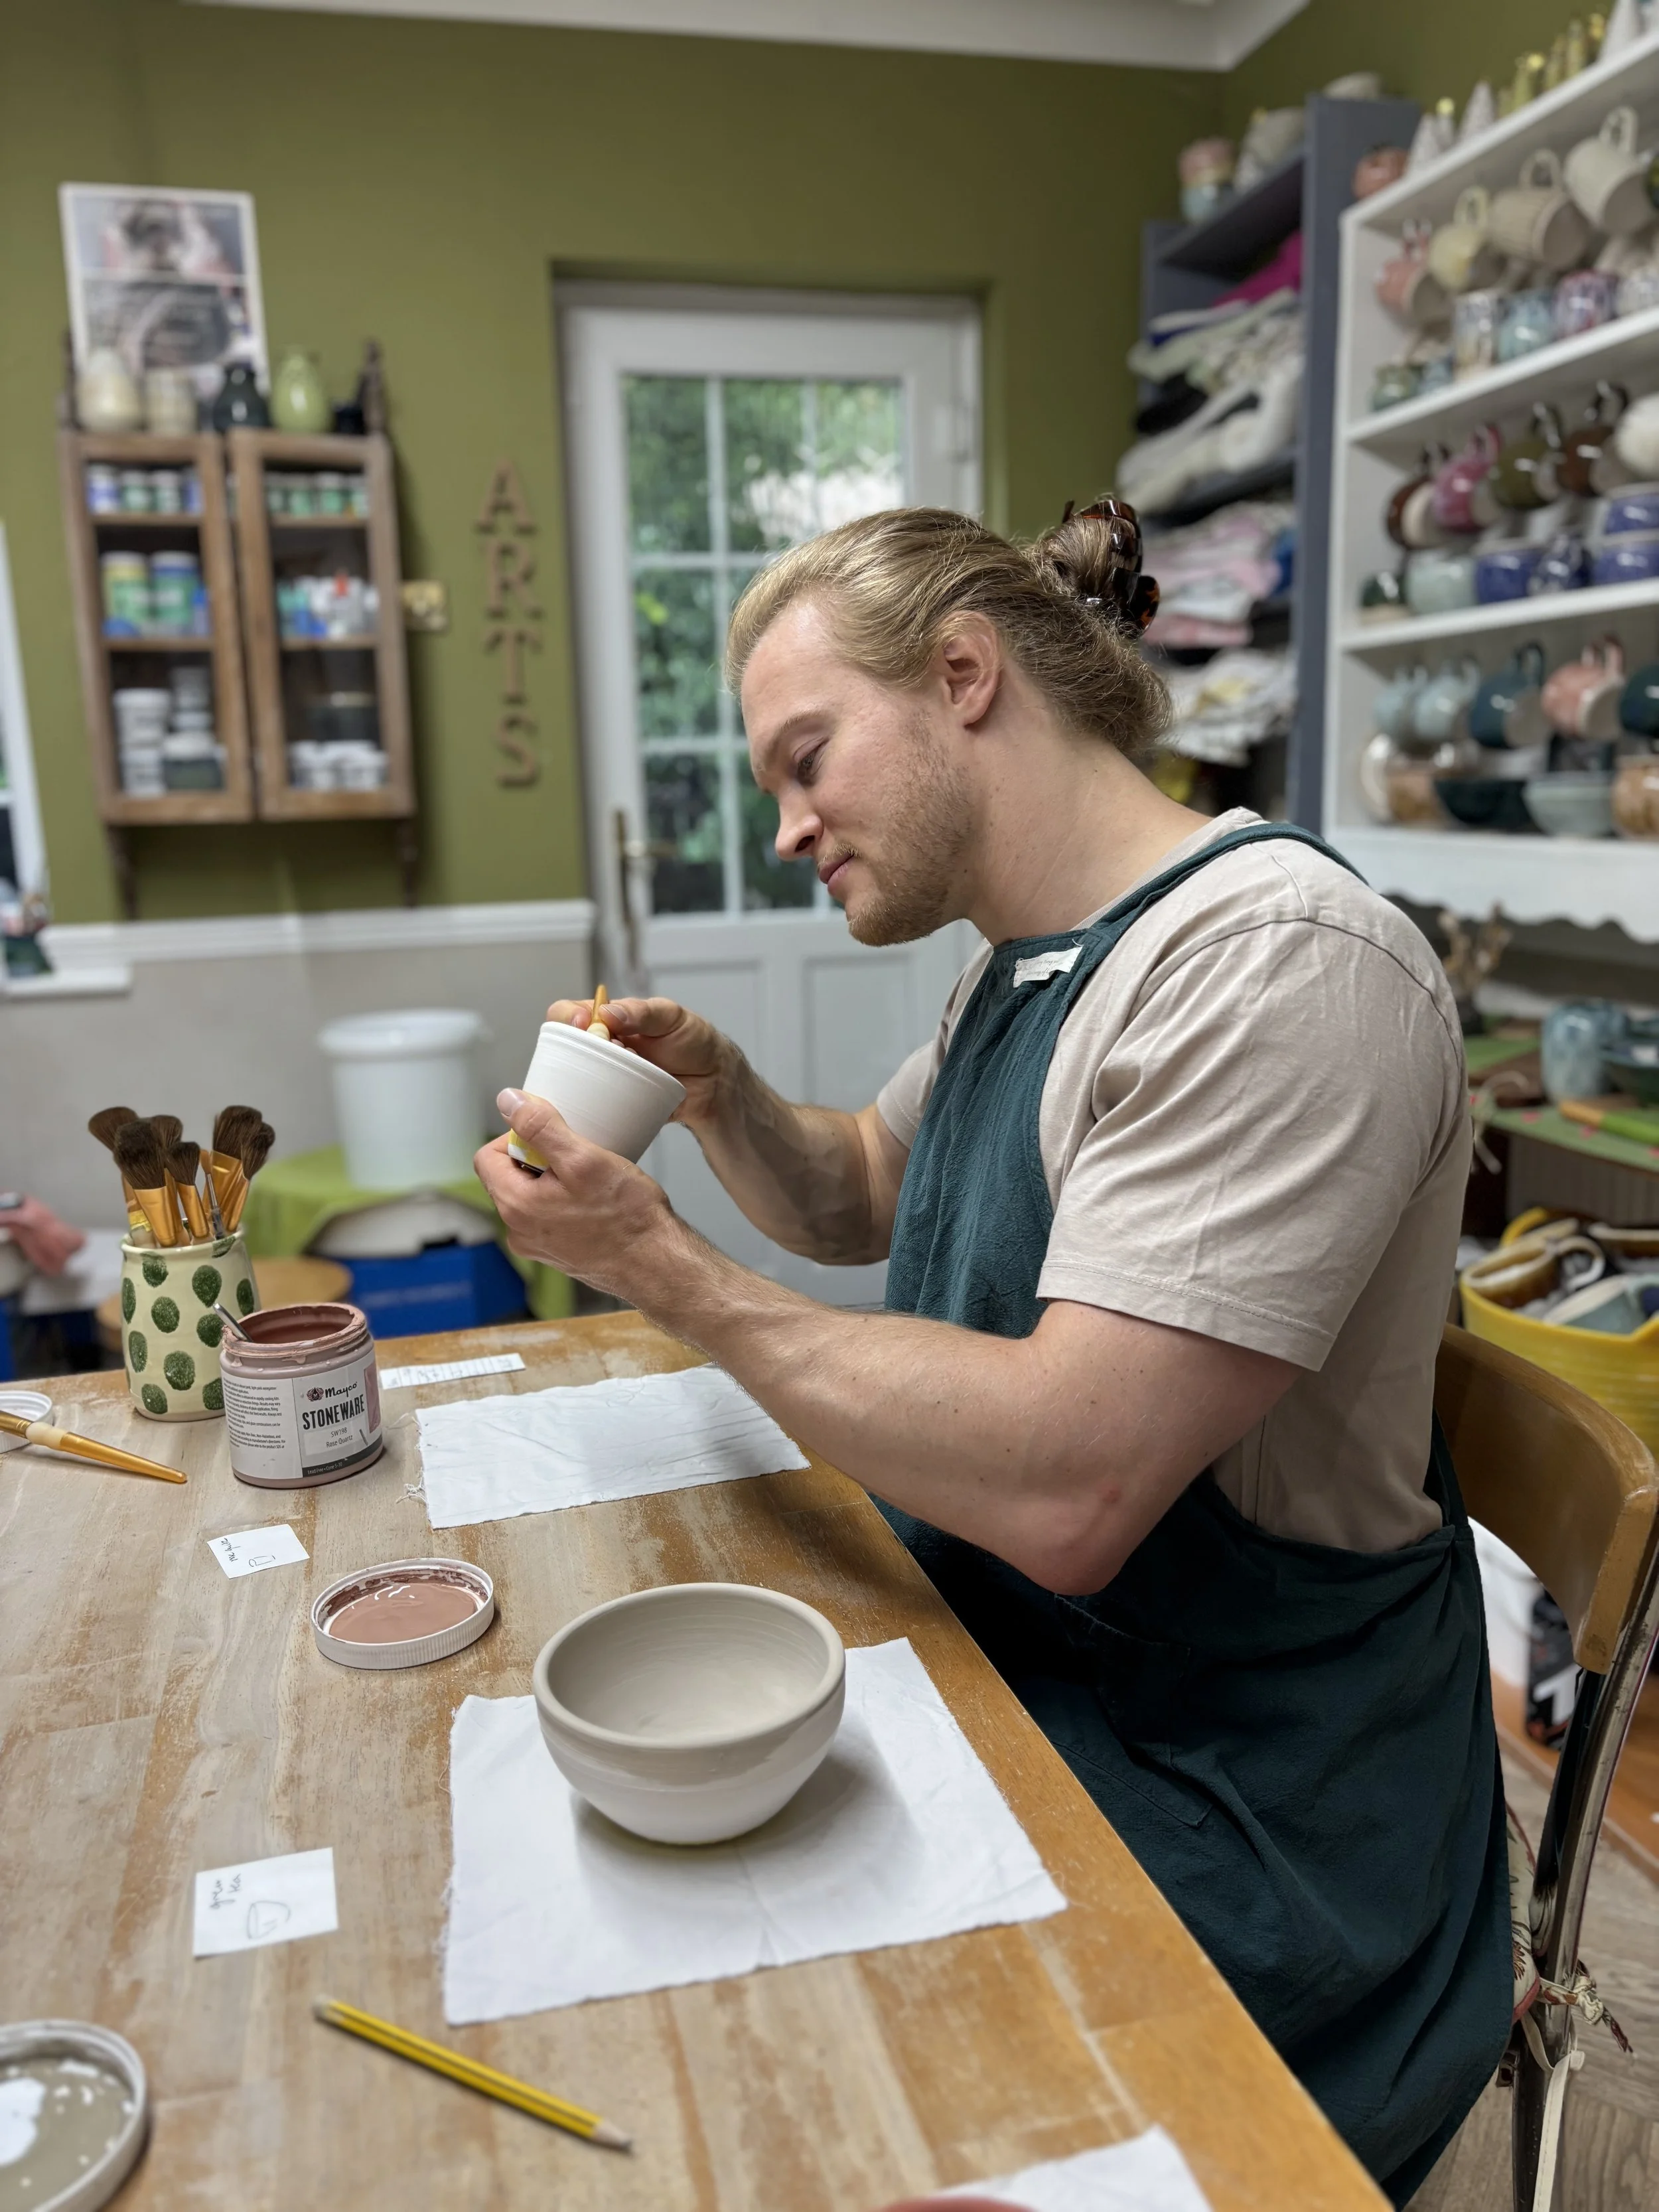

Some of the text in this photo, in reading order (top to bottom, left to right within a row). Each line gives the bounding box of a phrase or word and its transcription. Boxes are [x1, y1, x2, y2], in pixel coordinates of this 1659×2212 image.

[474, 461, 543, 786] ARTS
[325, 1383, 356, 1398] Mayco
[302, 1394, 365, 1430] STONEWARE
[330, 1427, 348, 1438] SW198
[338, 1435, 353, 1444] Quartz
